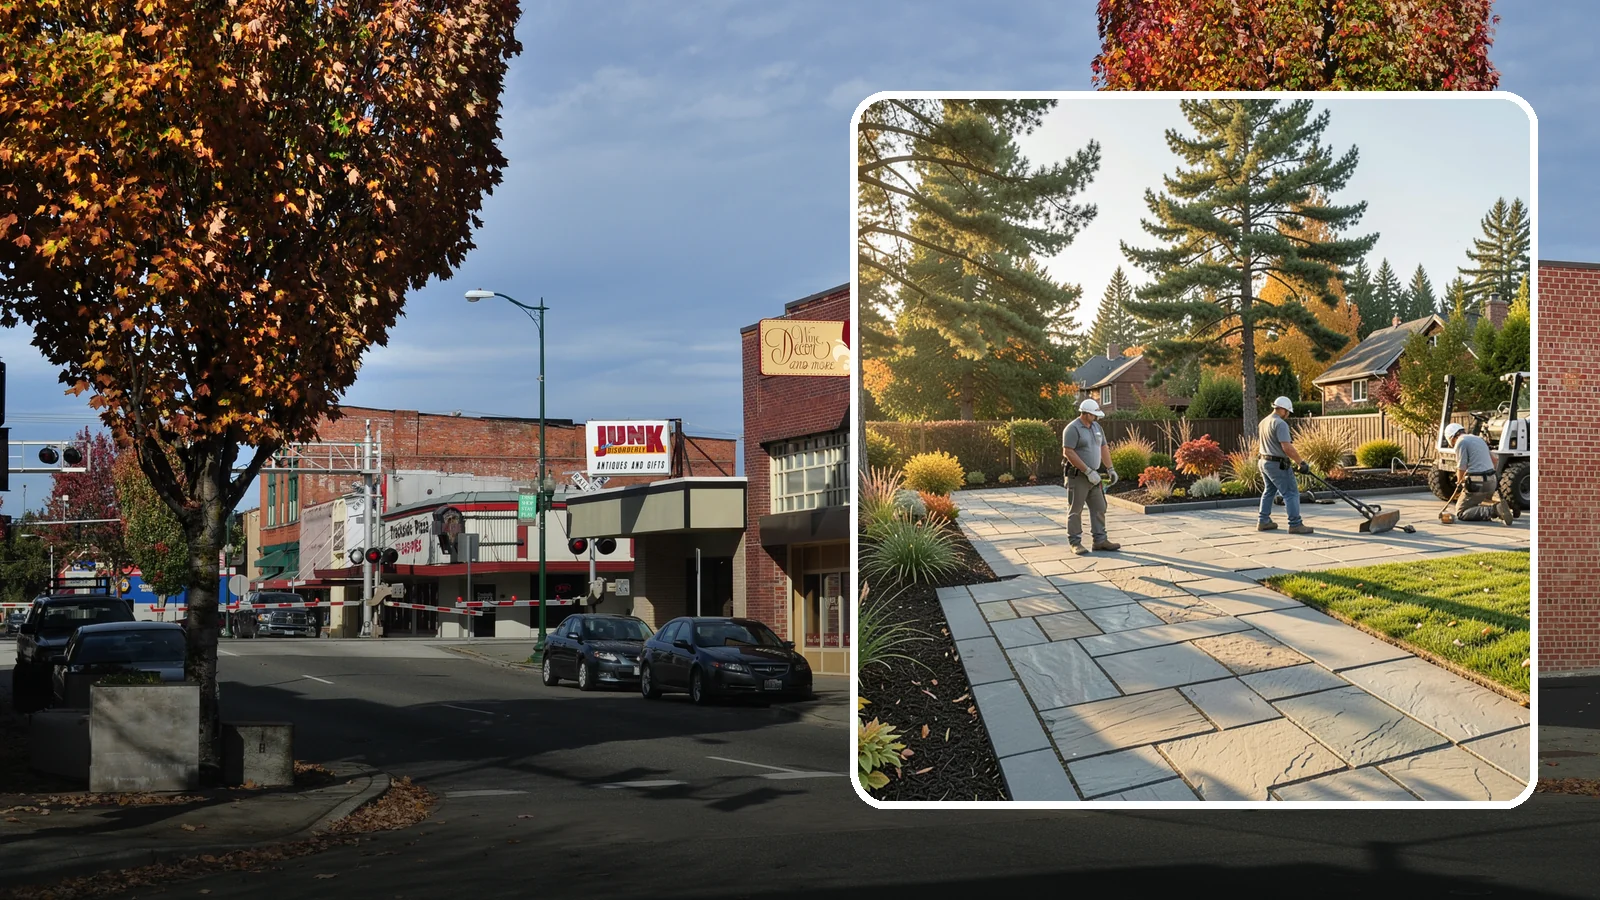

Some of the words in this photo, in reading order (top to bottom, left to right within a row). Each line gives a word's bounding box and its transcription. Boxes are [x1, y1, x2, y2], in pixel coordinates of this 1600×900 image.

[595, 425, 664, 457] JUNK
[607, 446, 645, 454] DISORDERLY
[597, 461, 628, 470] ANTIQUES
[631, 461, 644, 470] AND
[647, 460, 665, 470] GIFTS
[390, 521, 412, 539] Trackside
[414, 519, 429, 535] Pizza
